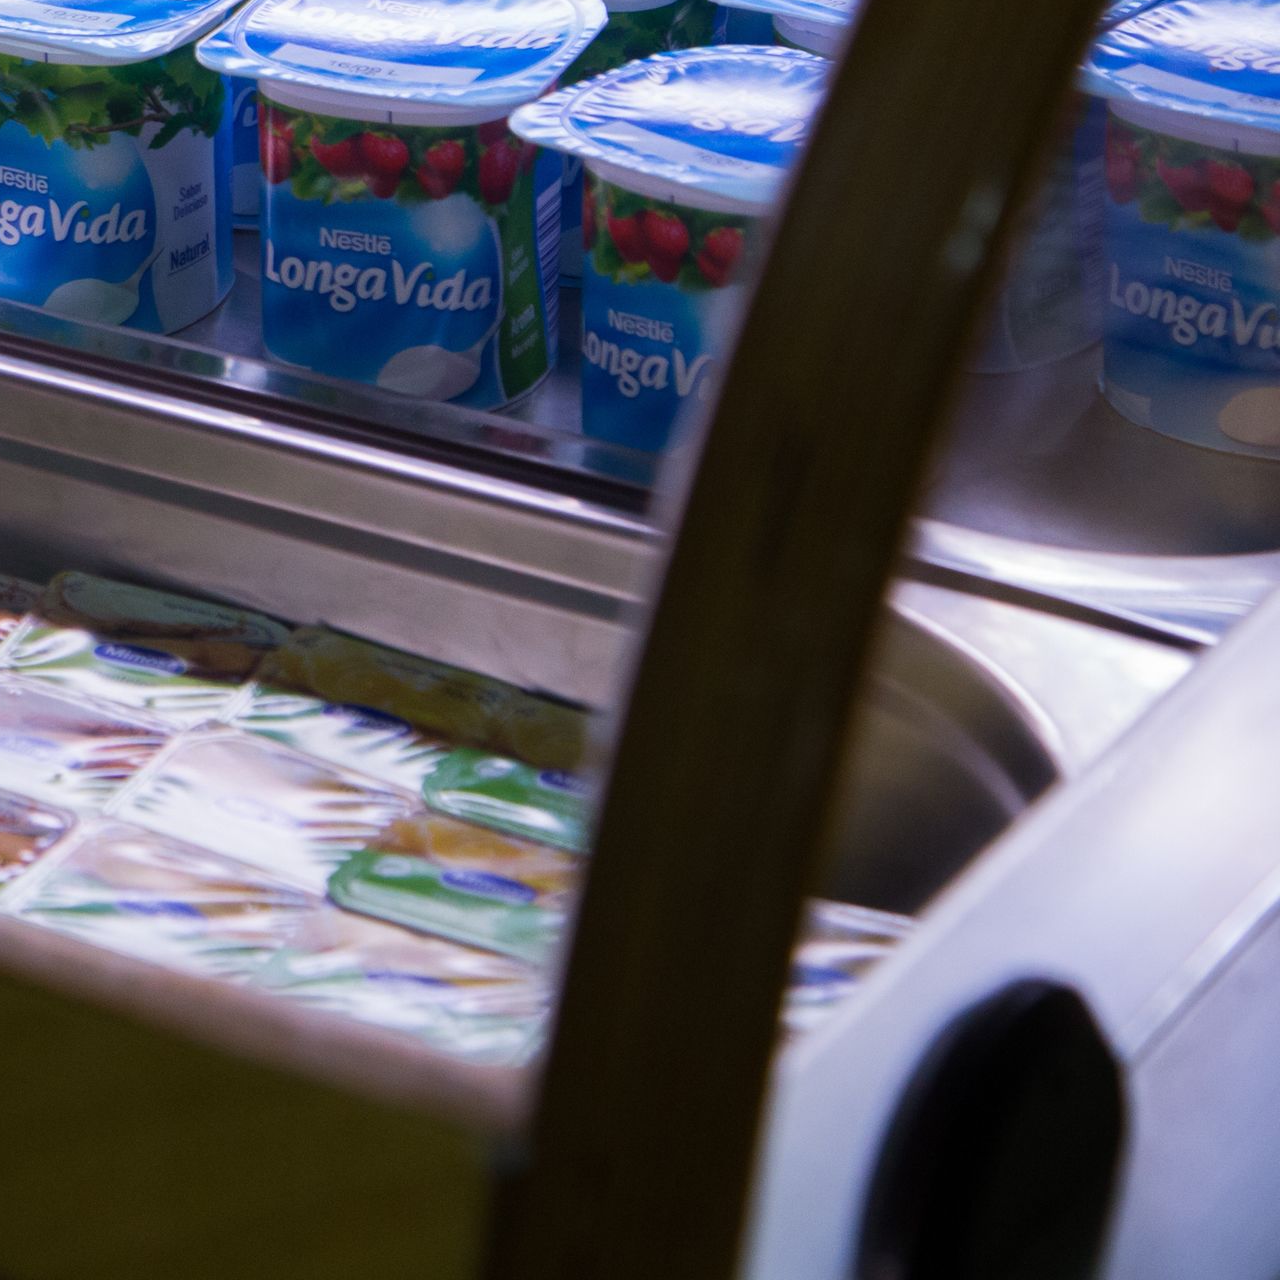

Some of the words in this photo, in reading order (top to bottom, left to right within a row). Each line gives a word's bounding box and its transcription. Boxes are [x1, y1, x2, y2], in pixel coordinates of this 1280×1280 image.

[49, 198, 148, 245] Vida
[320, 227, 392, 256] Nestlé
[170, 232, 211, 271] Natural
[266, 238, 388, 312] Longa
[392, 259, 492, 312] Vida
[1165, 256, 1233, 292] Nestlé
[608, 308, 675, 342] Nestlé
[1109, 263, 1228, 346] Longa
[582, 330, 670, 399] onga
